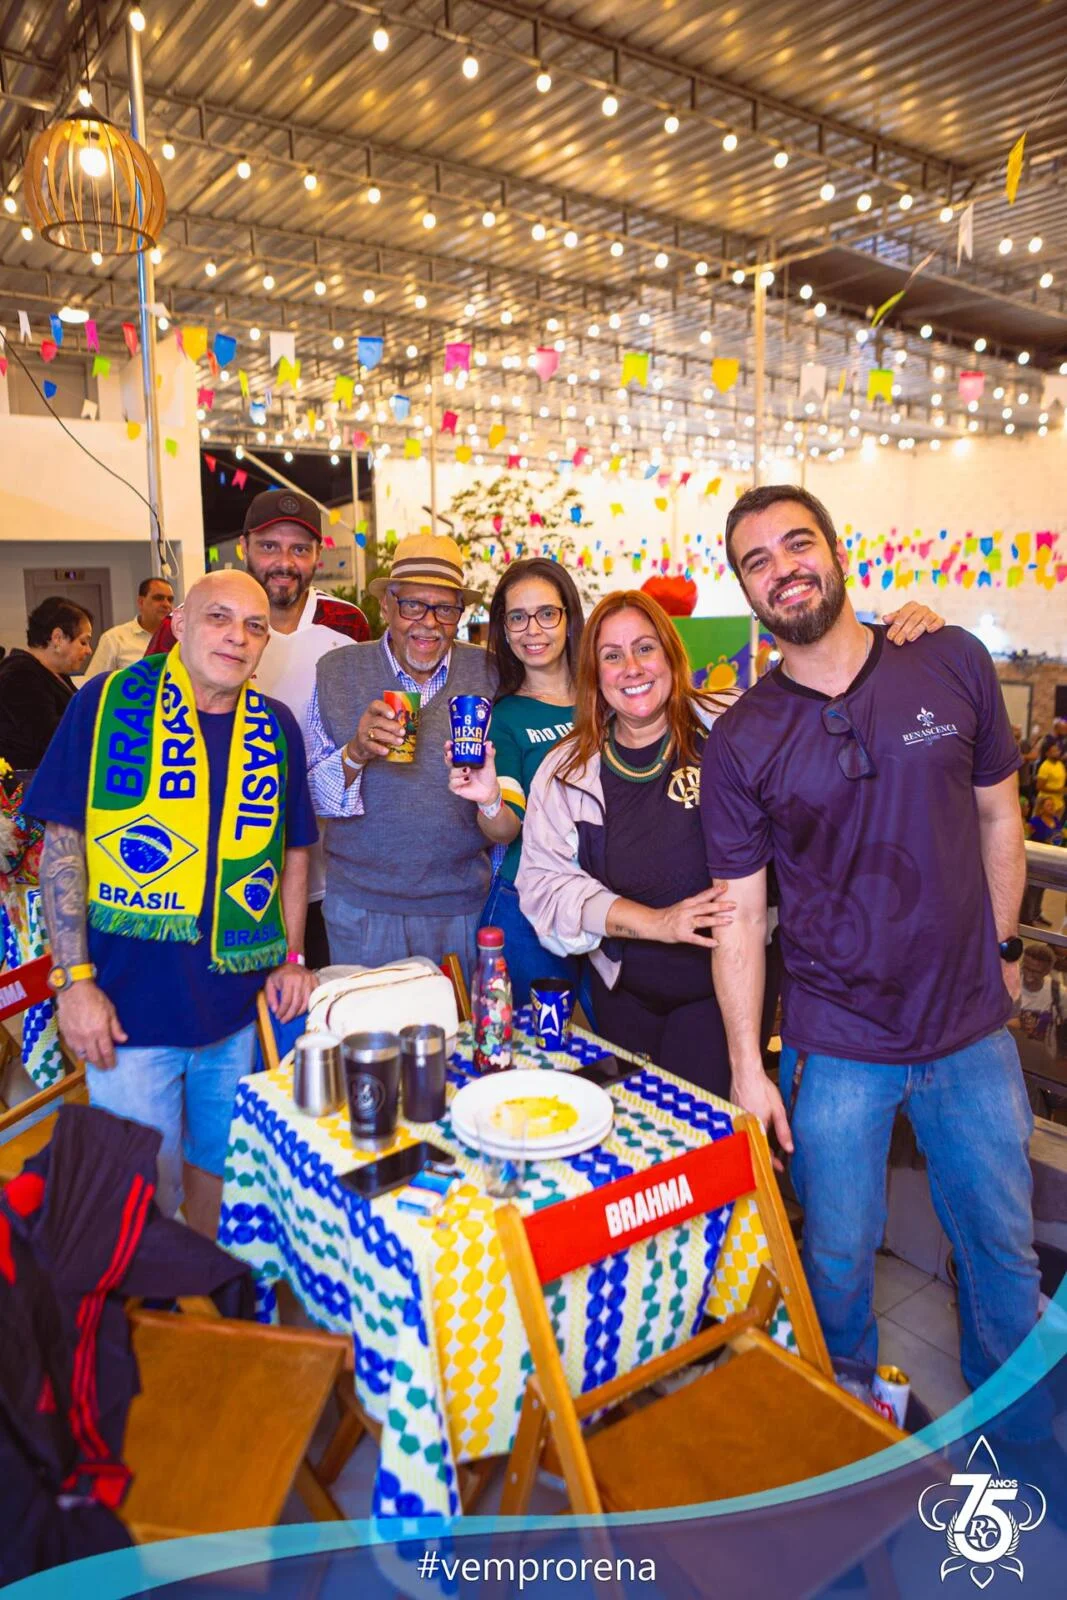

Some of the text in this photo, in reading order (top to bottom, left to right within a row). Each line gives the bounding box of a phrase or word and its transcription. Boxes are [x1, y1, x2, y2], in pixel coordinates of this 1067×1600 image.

[454, 725, 483, 738] HEXA
[526, 727, 557, 744] RIO
[454, 741, 482, 756] RENA
[234, 689, 284, 841] BRASIL
[98, 882, 186, 910] BRASIL
[223, 922, 280, 947] BRASIL
[605, 1173, 694, 1239] BRAHMA
